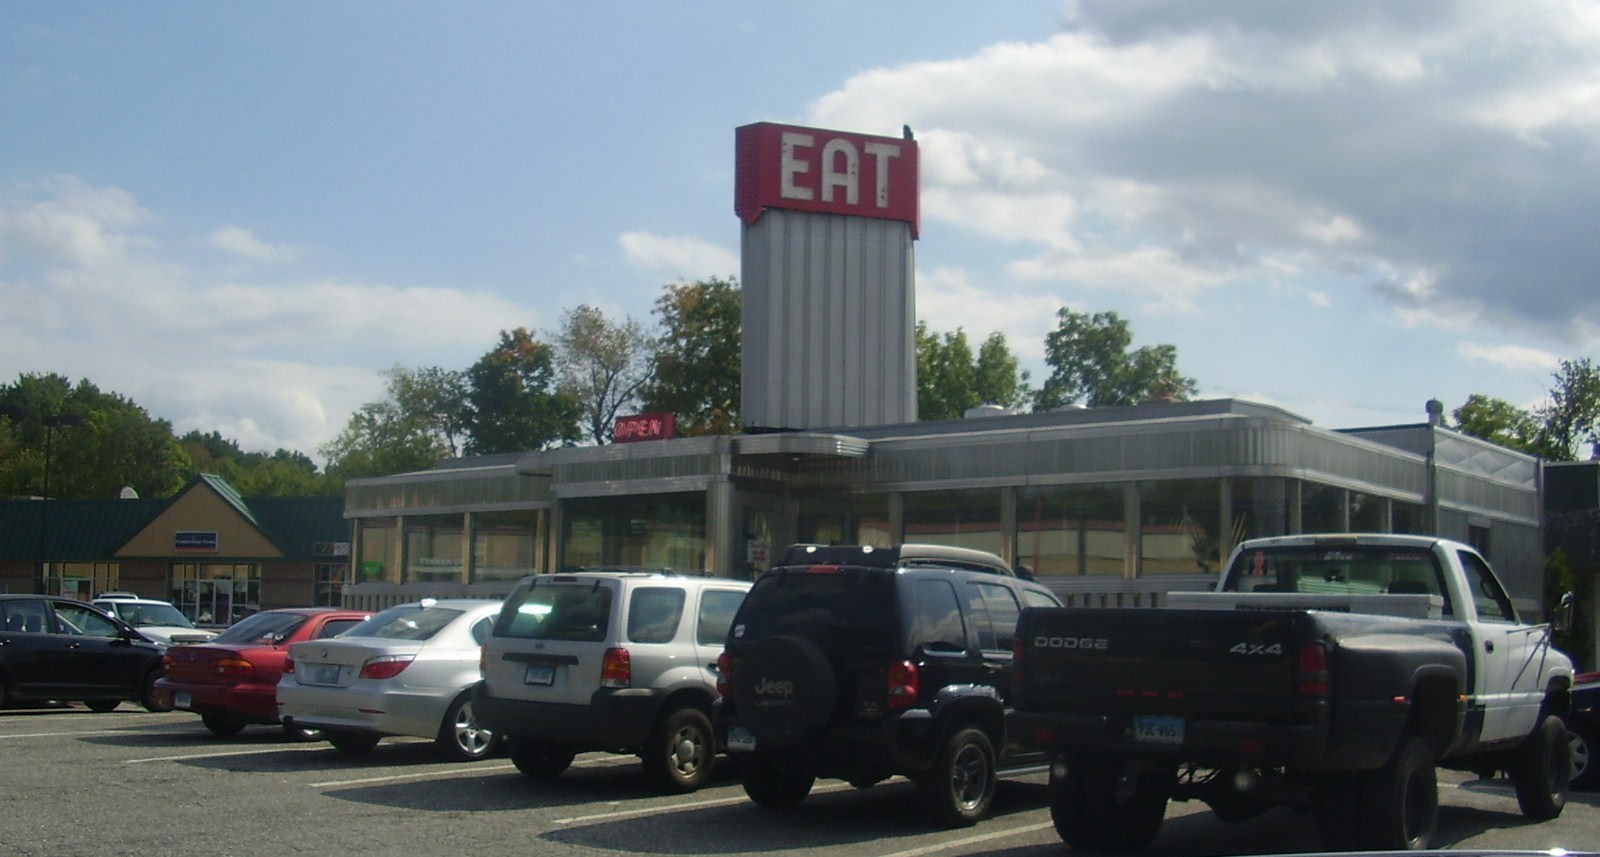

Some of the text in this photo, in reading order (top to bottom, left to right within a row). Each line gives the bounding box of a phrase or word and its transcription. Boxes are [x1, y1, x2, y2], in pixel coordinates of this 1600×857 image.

[780, 131, 900, 209] EAT
[615, 419, 661, 438] OPEN
[1034, 636, 1109, 651] DODGE
[754, 677, 794, 698] Jeep
